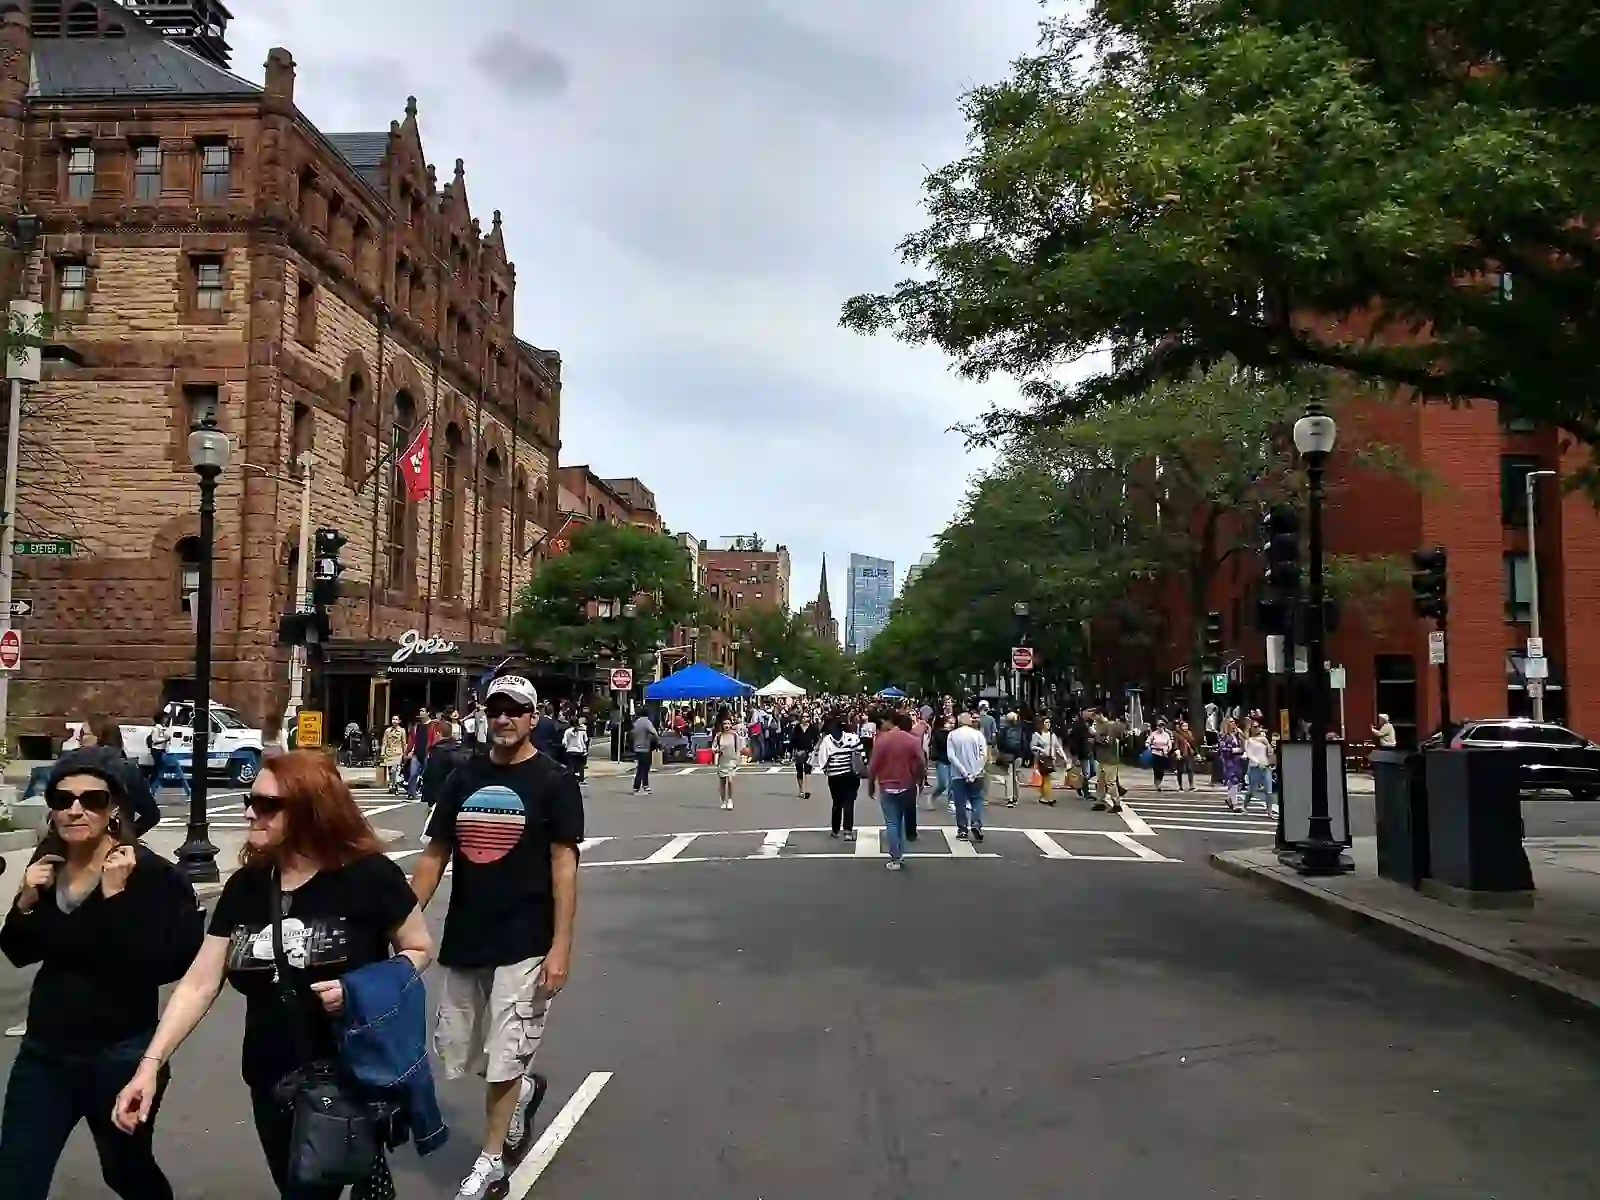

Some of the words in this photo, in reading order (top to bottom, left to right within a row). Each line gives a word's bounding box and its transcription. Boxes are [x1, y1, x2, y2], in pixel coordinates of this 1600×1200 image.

[30, 543, 57, 553] EXETER
[391, 629, 456, 662] Joe's
[387, 665, 422, 673] American
[423, 666, 437, 674] Bar
